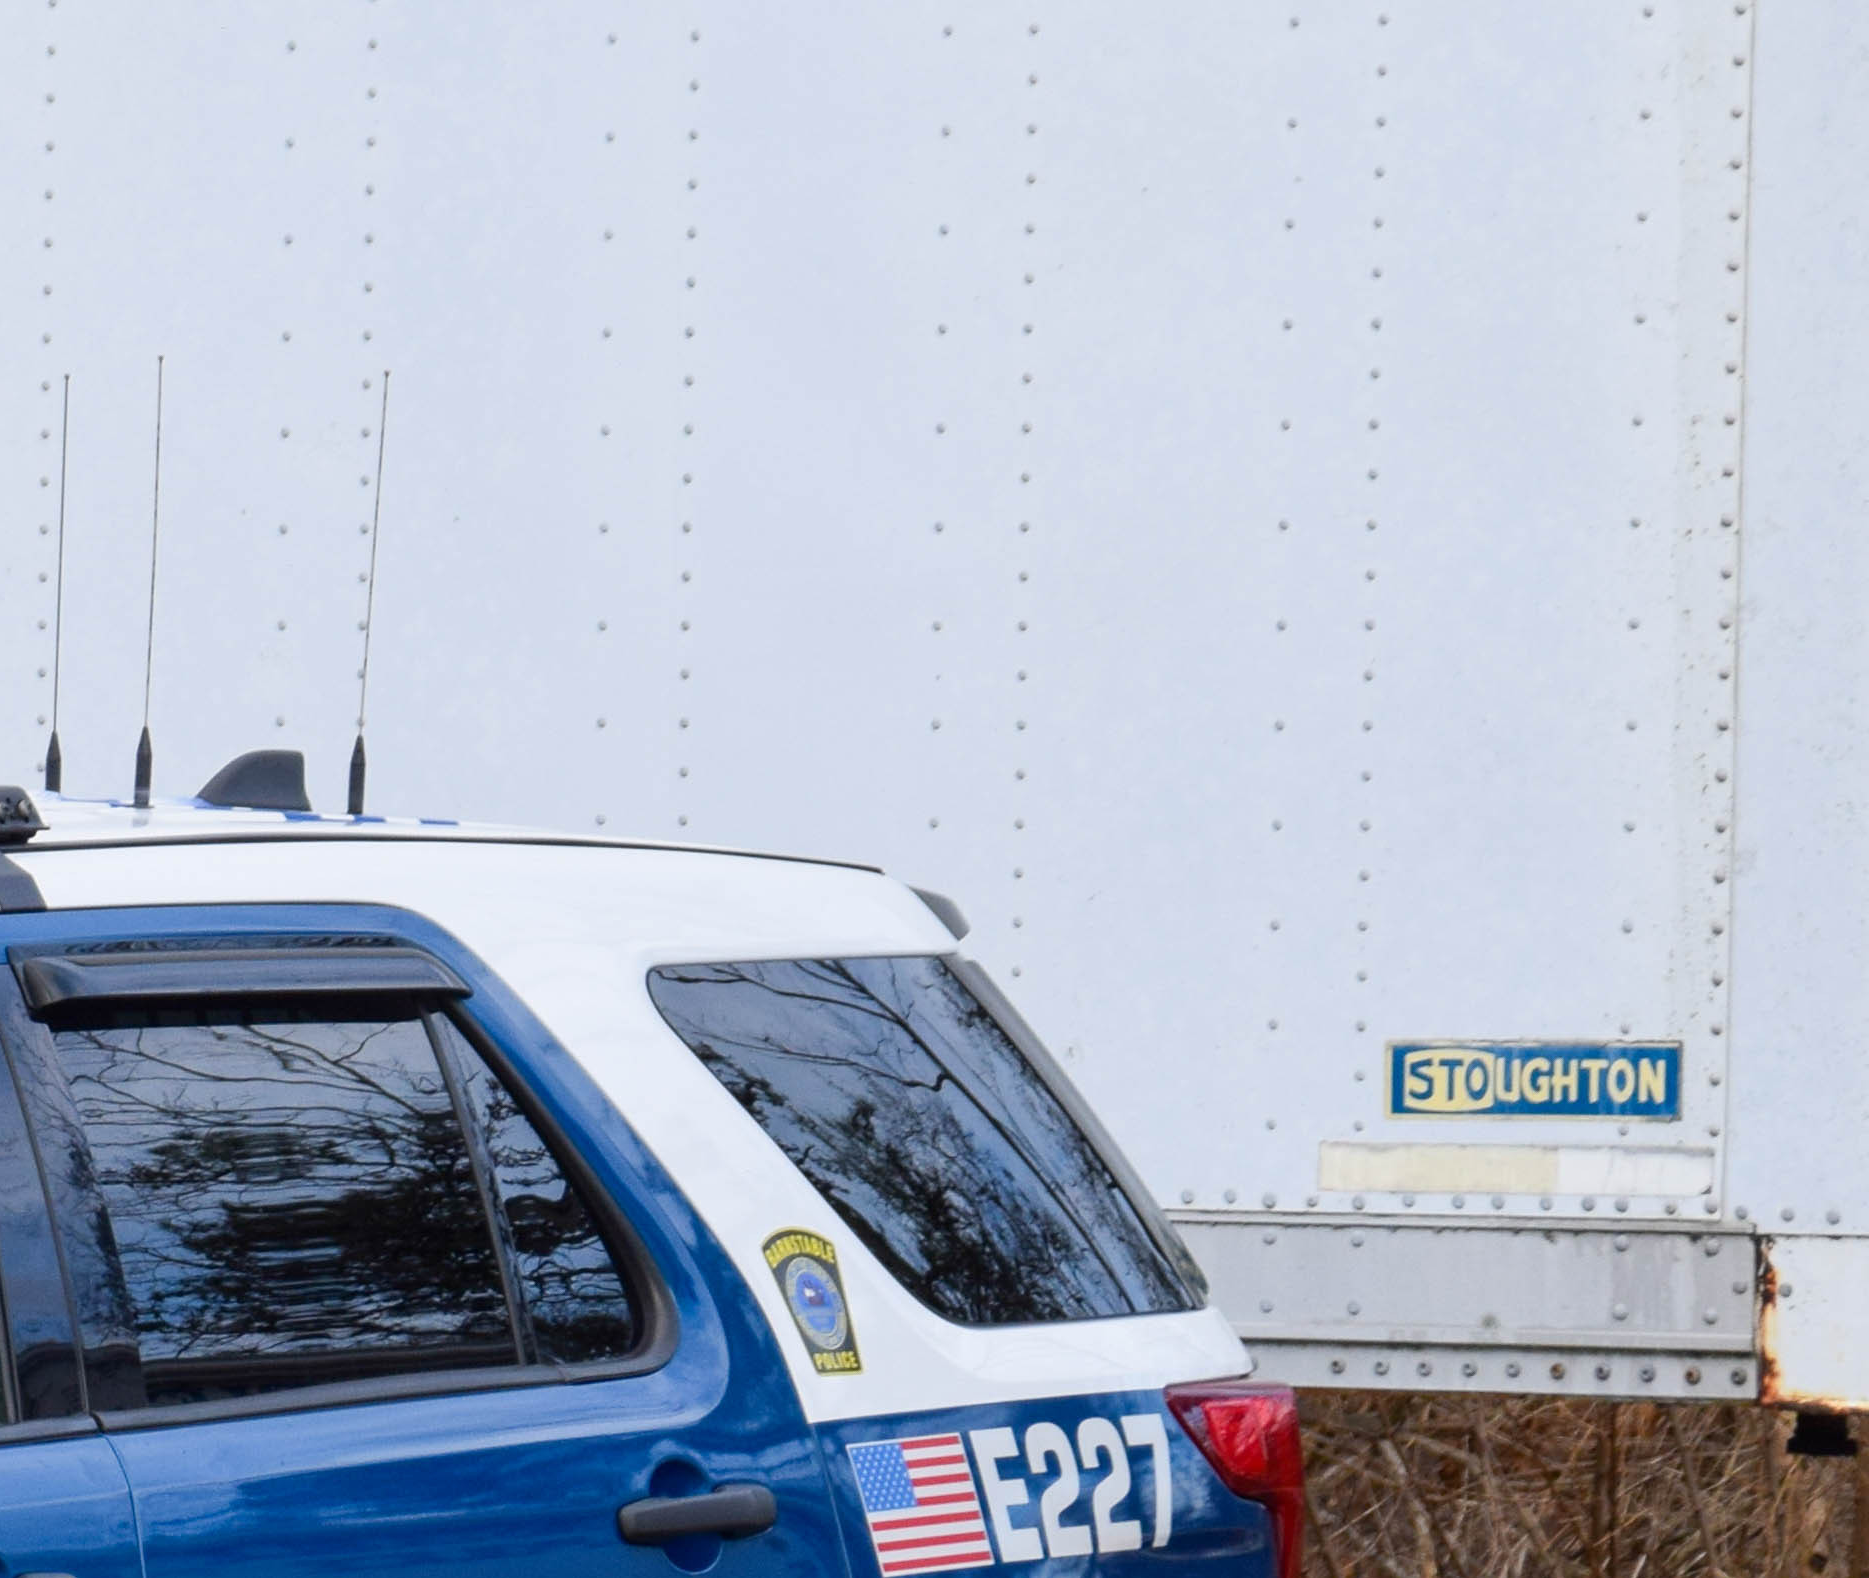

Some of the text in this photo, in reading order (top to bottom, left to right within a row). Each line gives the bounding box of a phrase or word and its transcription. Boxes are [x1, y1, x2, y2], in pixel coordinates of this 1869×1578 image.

[1407, 1057, 1667, 1105] STOUGHTON
[764, 1234, 836, 1269] BARNSTABLE
[812, 1350, 859, 1371] POLICE
[968, 1413, 1173, 1564] E227
